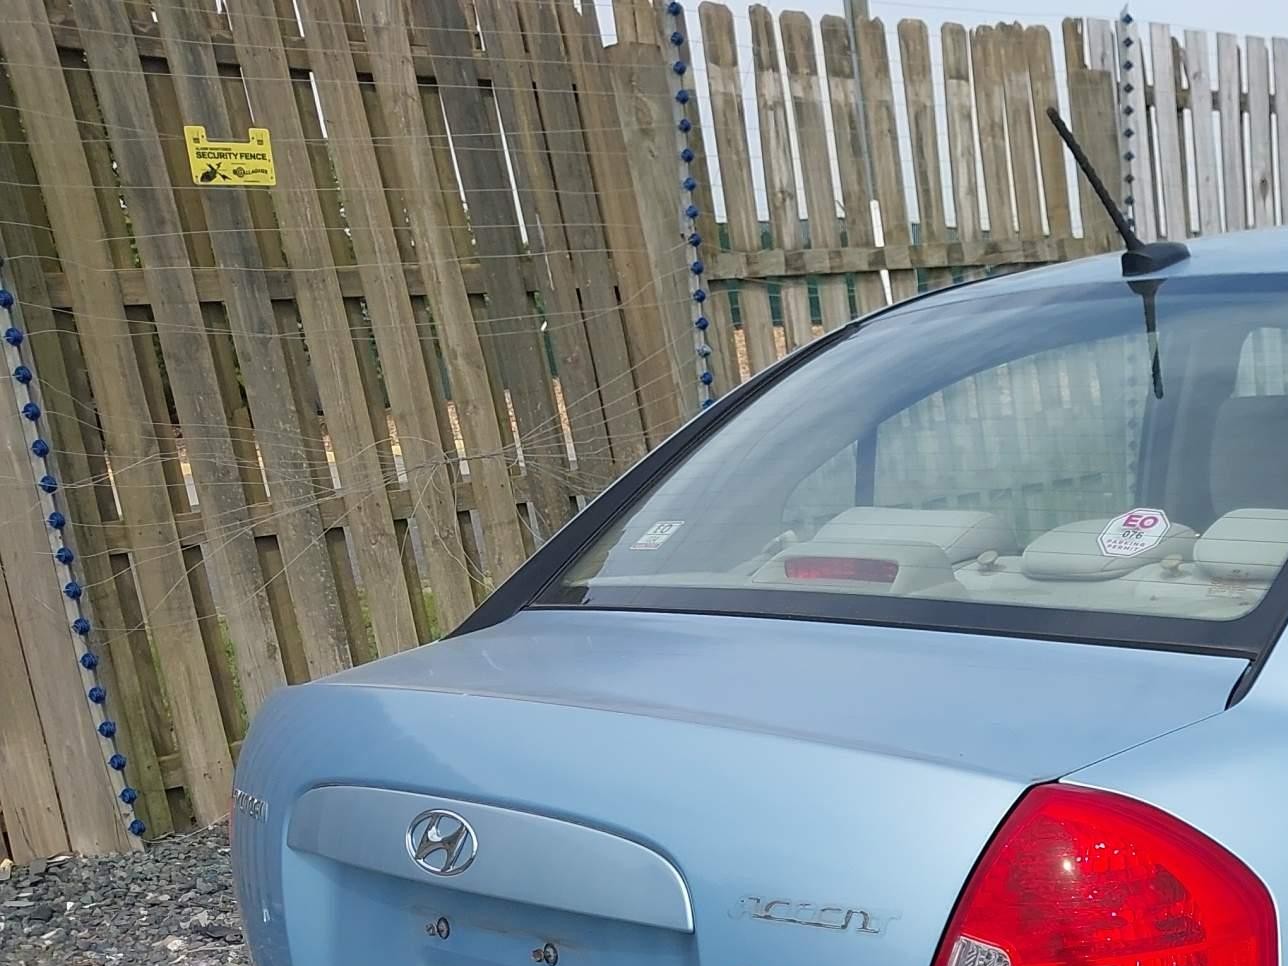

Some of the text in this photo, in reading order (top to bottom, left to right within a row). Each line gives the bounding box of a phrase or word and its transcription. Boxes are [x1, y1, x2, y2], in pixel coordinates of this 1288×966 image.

[195, 151, 268, 161] SECURITY FENCE
[1122, 514, 1160, 529] EO
[1121, 530, 1145, 540] 076
[1106, 538, 1147, 548] PARKING
[1106, 544, 1142, 552] PERMIT
